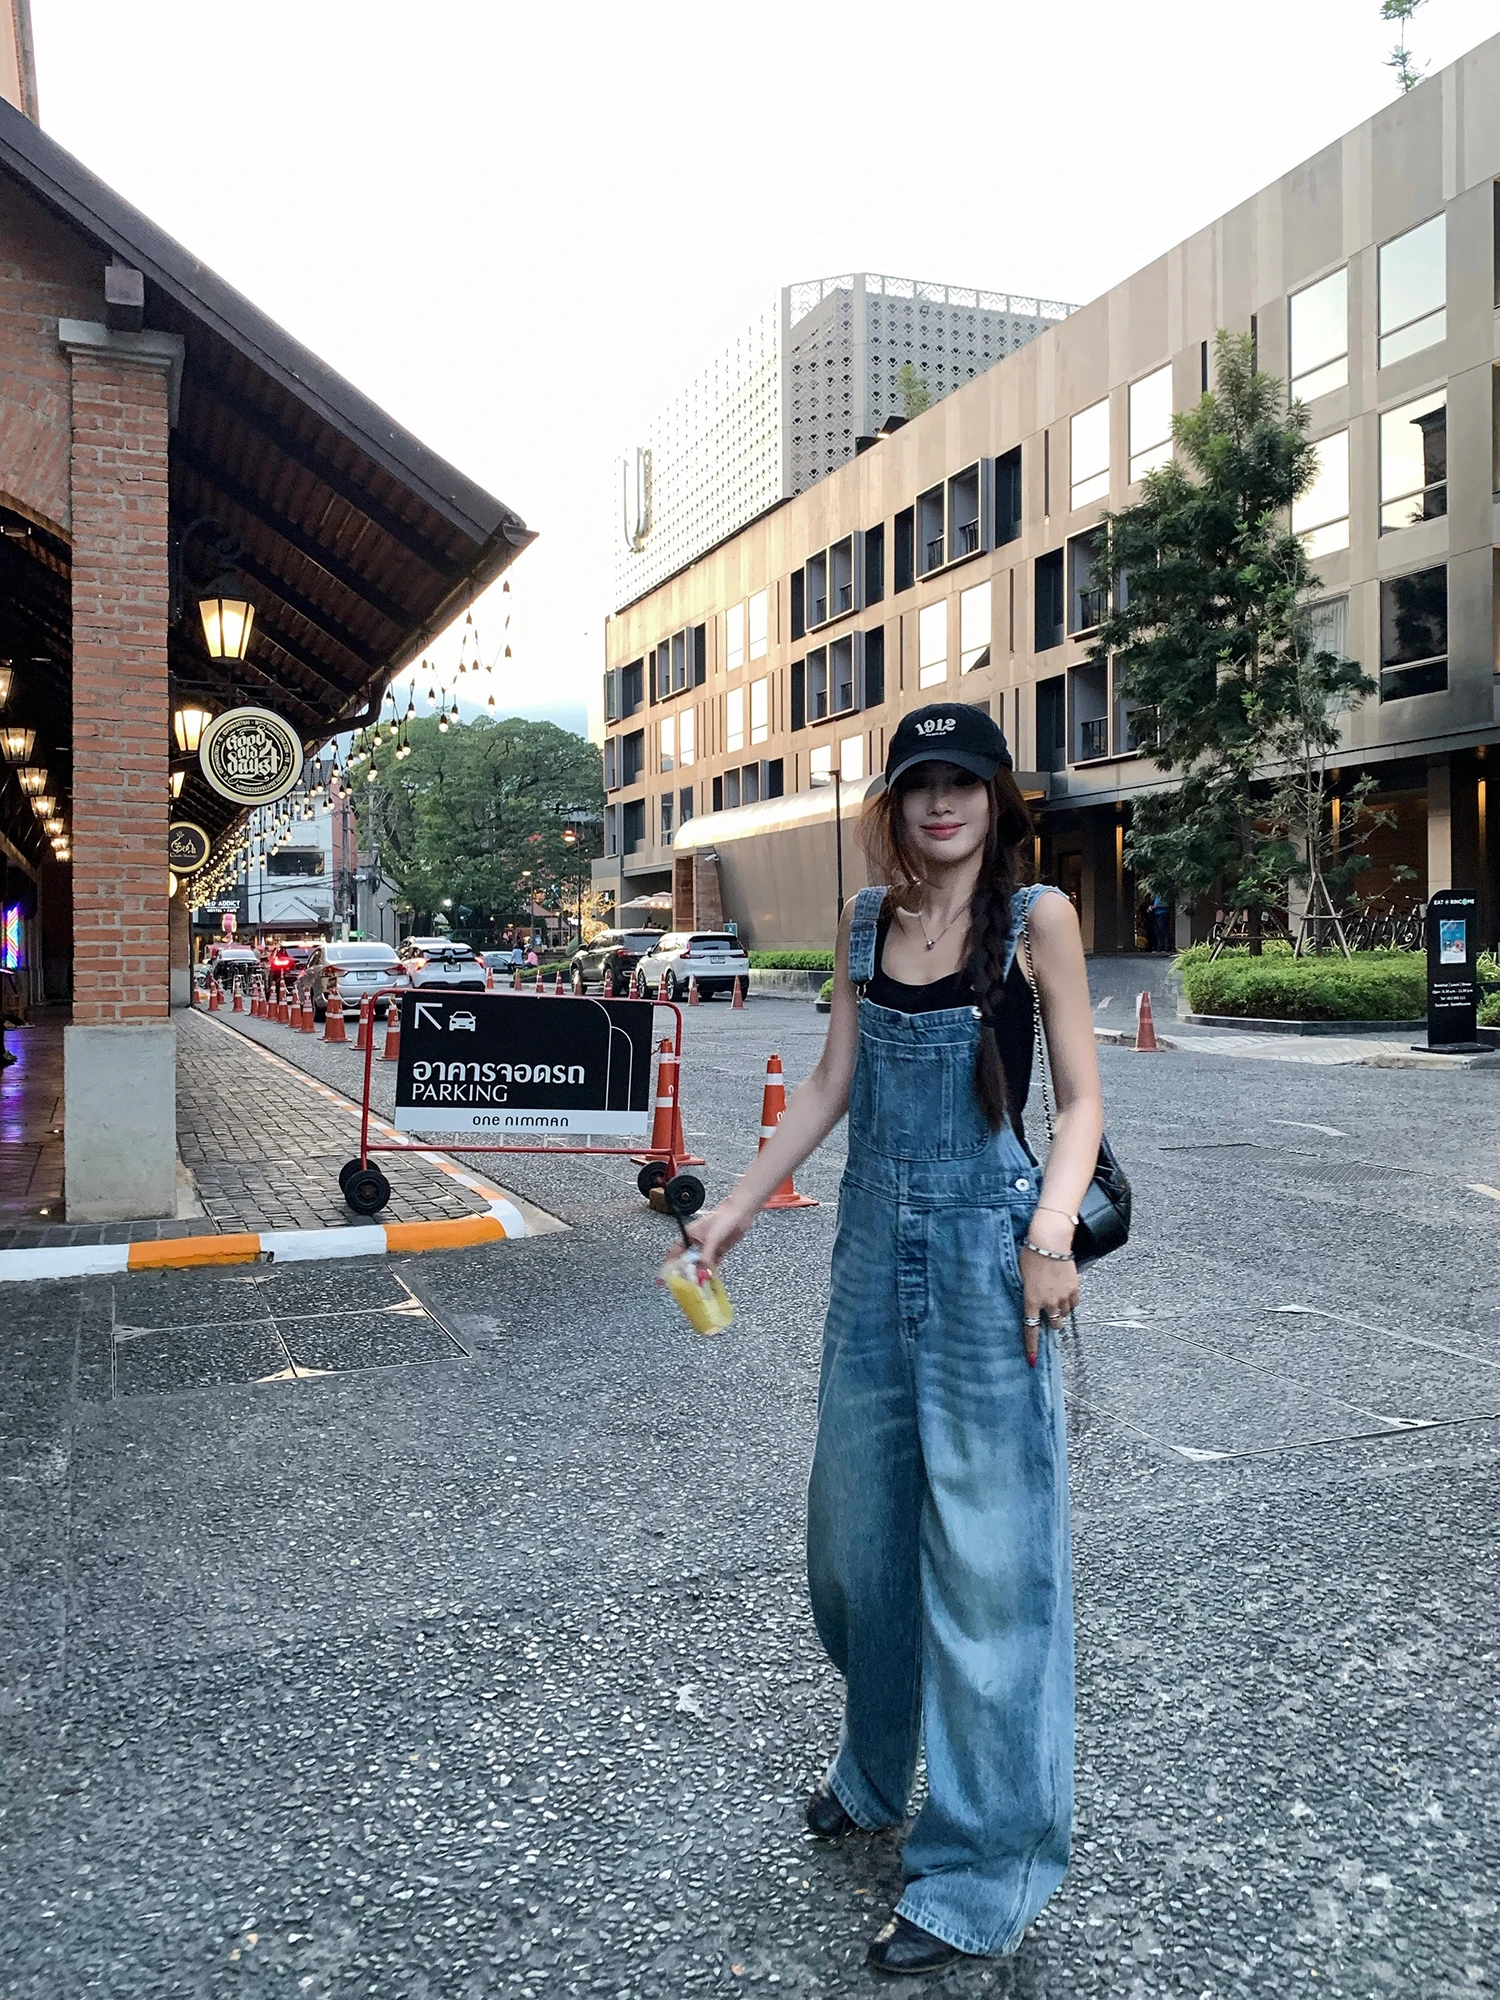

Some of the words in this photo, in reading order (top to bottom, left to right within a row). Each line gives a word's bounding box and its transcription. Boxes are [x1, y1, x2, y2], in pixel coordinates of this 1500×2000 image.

[914, 718, 957, 736] 1912
[226, 725, 266, 751] Good
[237, 745, 258, 760] old
[218, 899, 240, 907] ADDICT
[412, 1060, 586, 1085] อาคารจอดรถ
[411, 1083, 508, 1103] PARKING
